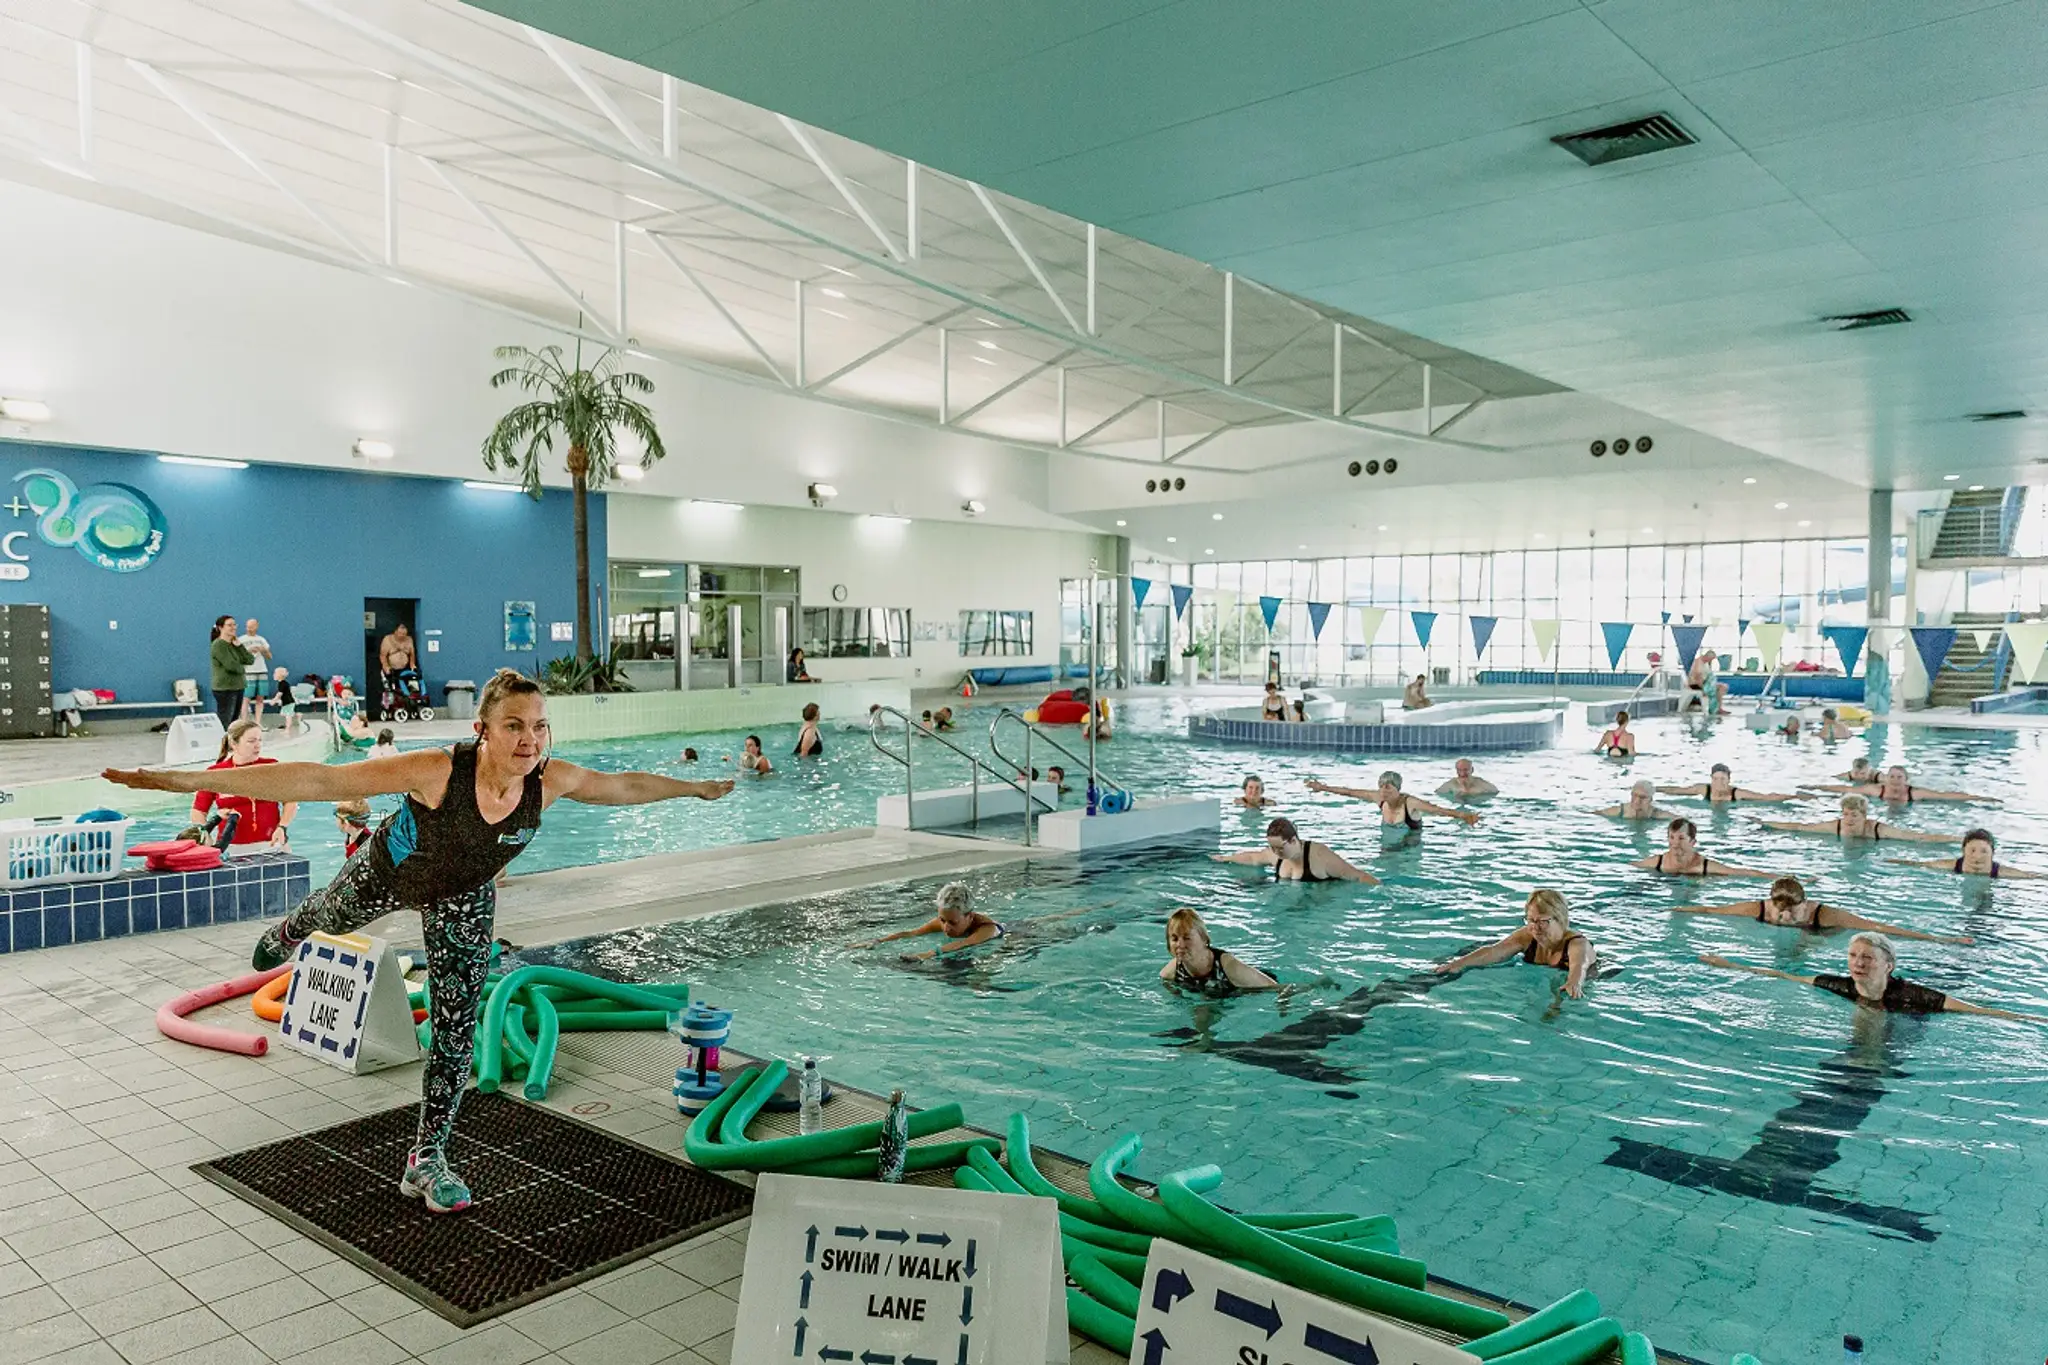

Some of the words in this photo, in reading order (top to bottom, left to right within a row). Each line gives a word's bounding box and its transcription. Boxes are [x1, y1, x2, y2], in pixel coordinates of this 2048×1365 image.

[40, 605, 47, 613] 4
[3, 631, 10, 639] 7
[38, 656, 50, 664] 12
[39, 681, 50, 690] 16
[37, 706, 51, 716] 20
[306, 966, 356, 1003] WALKING
[309, 1000, 340, 1031] LANE
[821, 1248, 881, 1276] SWIM
[898, 1254, 964, 1283] WALK
[867, 1294, 927, 1322] LANE
